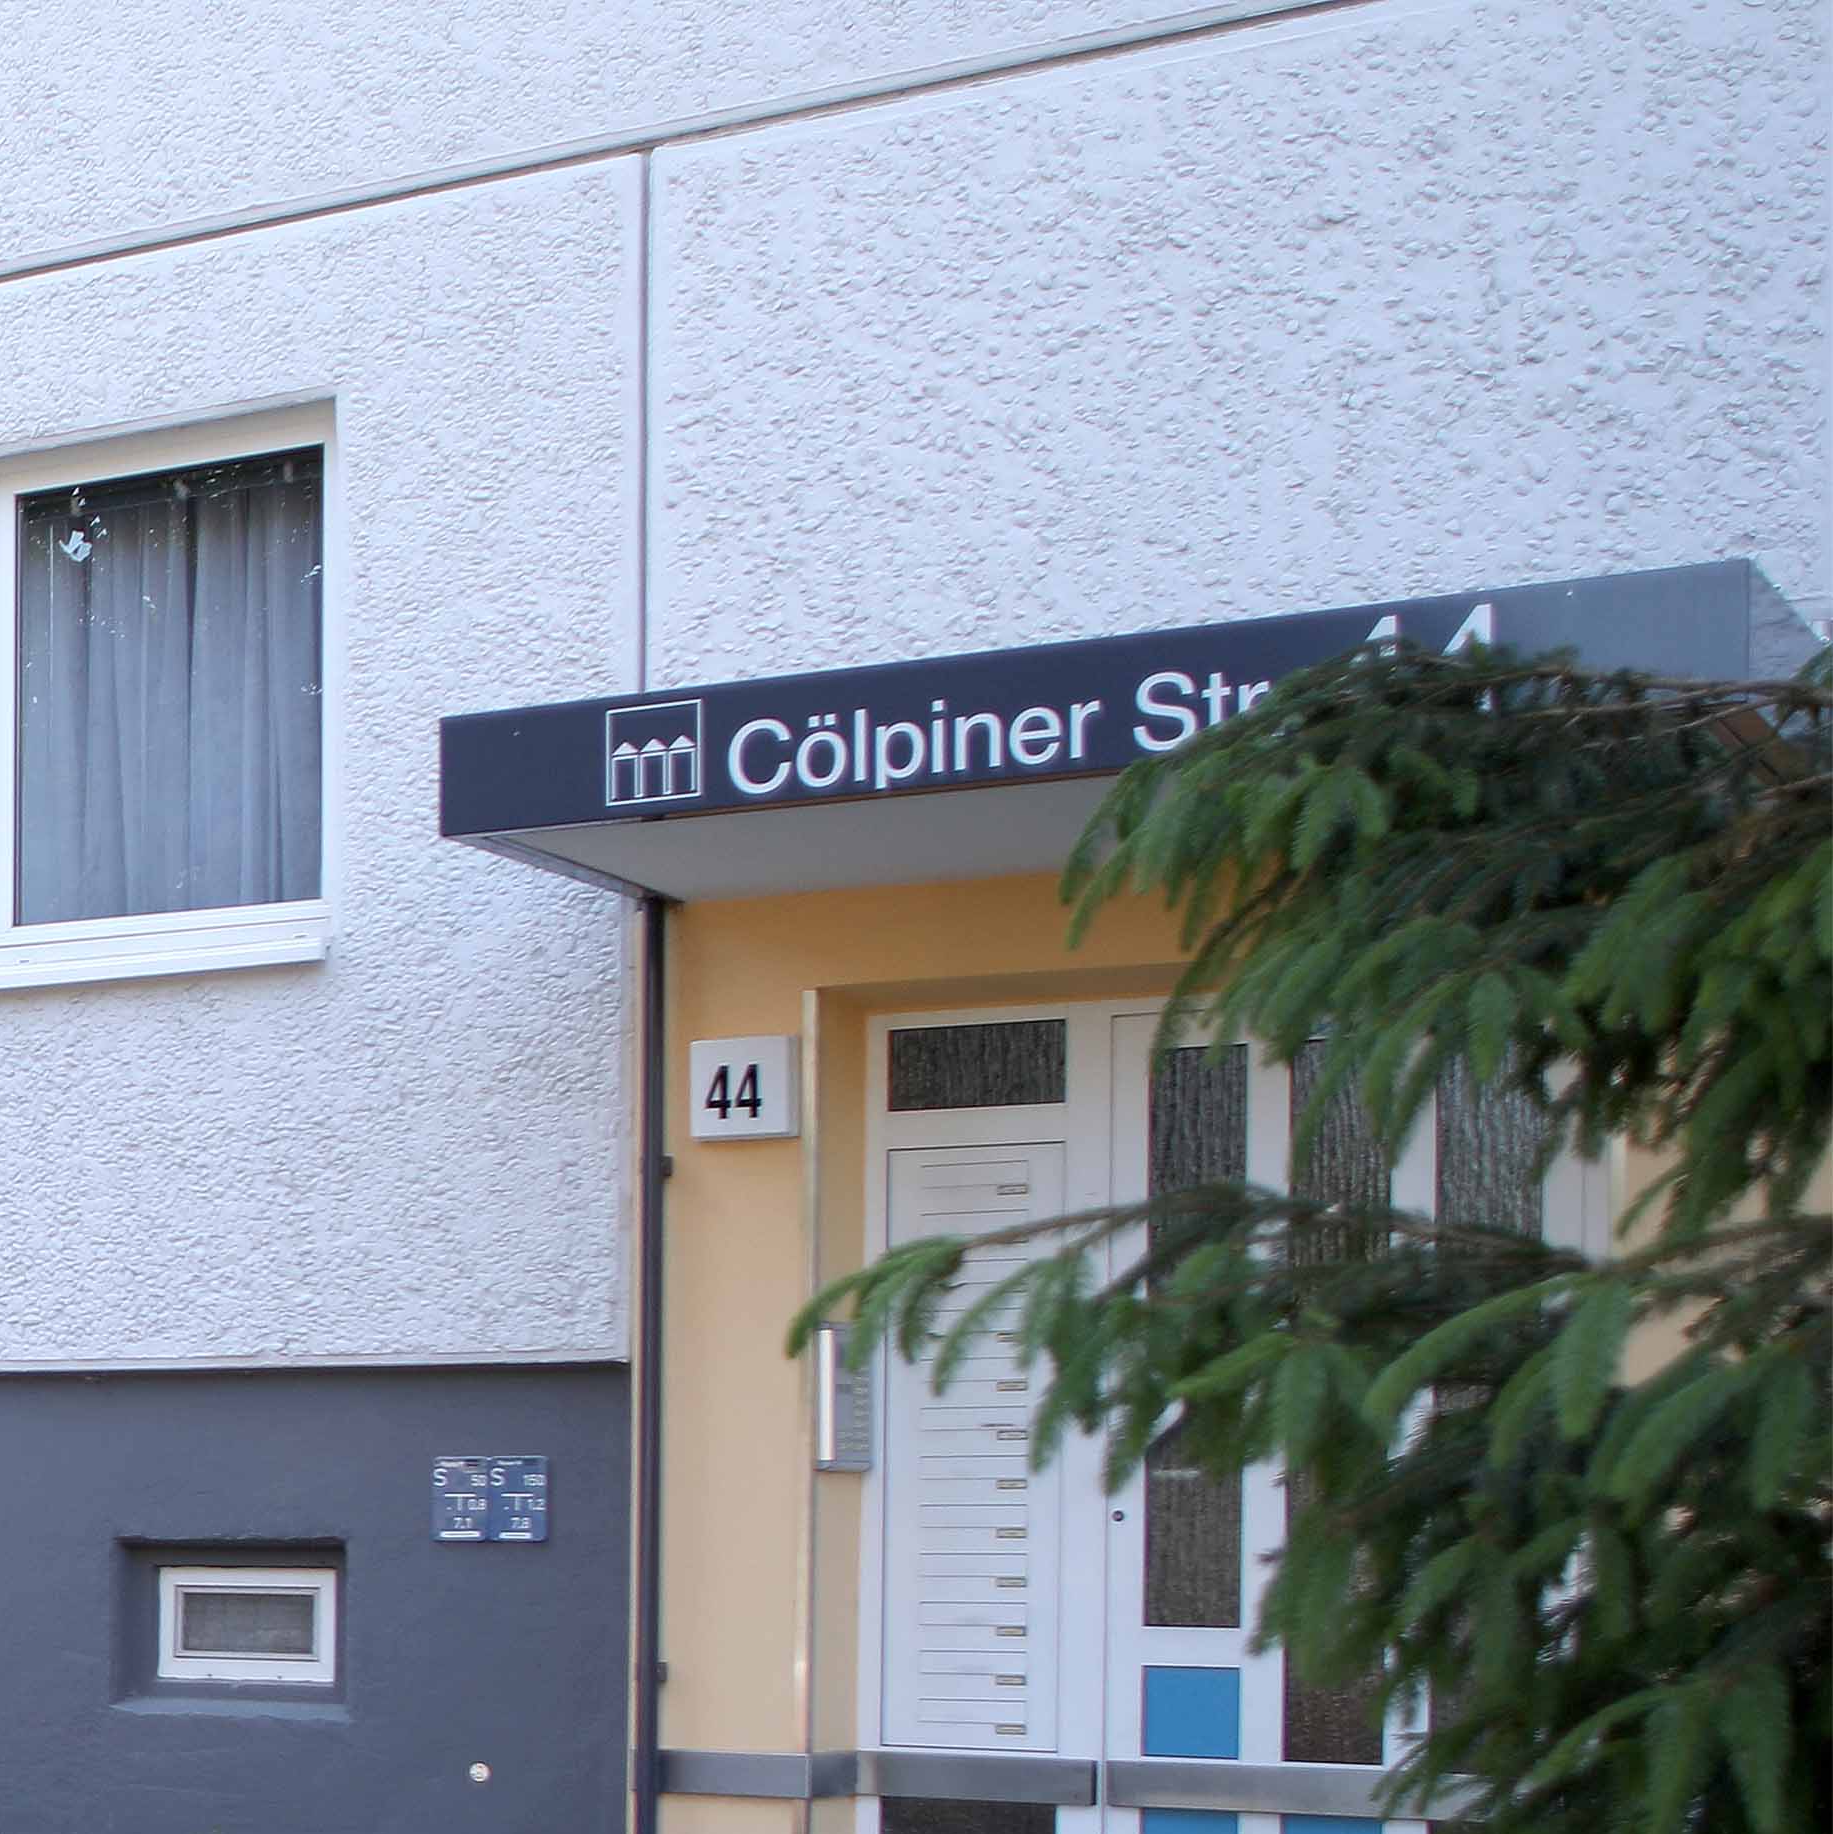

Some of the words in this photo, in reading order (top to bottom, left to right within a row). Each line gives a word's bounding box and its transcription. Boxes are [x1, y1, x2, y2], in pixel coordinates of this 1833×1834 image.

[727, 697, 1101, 794] Cölpiner
[1133, 670, 1281, 752] Str
[705, 1062, 763, 1120] 44
